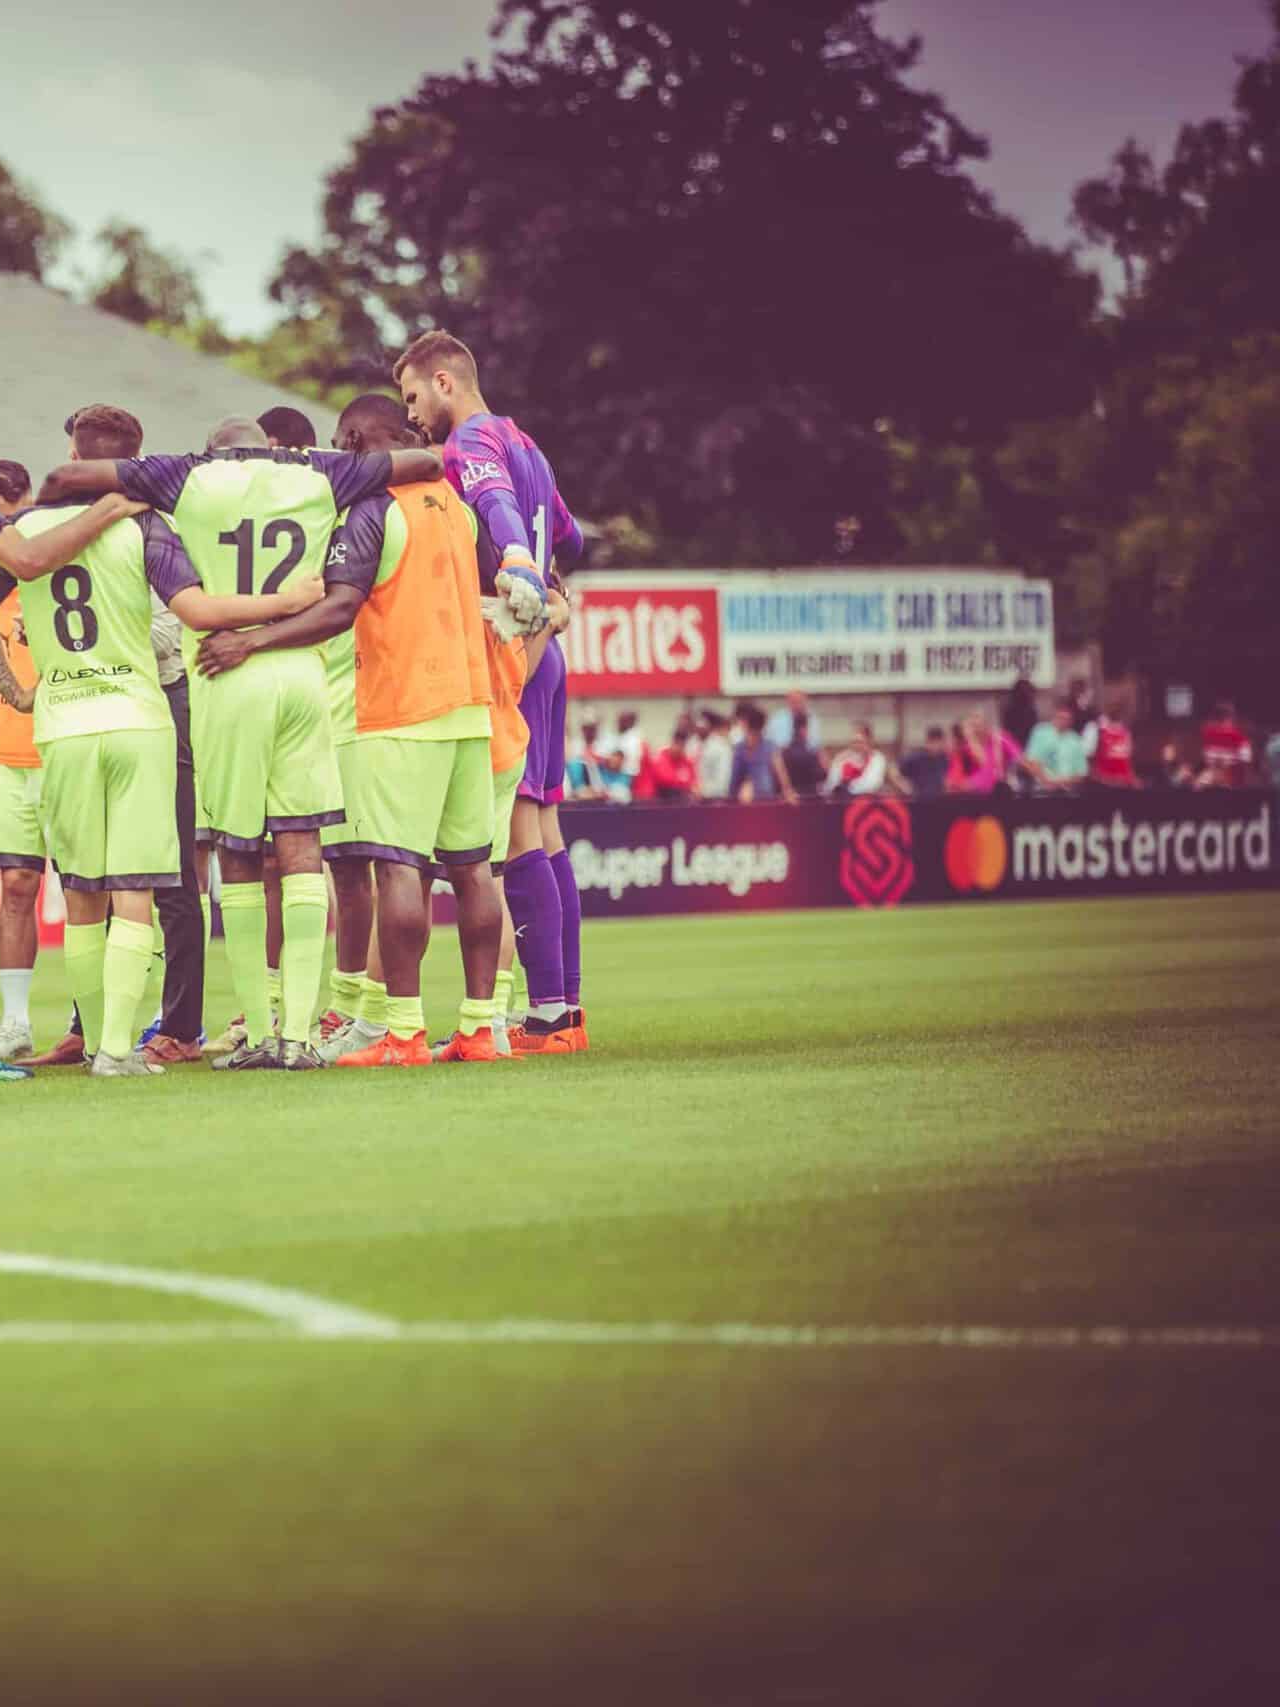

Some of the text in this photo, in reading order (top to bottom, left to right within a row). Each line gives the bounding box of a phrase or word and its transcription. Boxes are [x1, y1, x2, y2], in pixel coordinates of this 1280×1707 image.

[218, 518, 307, 595] 12
[50, 564, 98, 652] 8
[570, 594, 706, 675] irates
[896, 591, 935, 630] CAR
[943, 590, 1004, 630] SALES
[67, 664, 133, 680] LEXUS
[570, 836, 790, 901] Super League
[1013, 804, 1271, 881] mastercard
